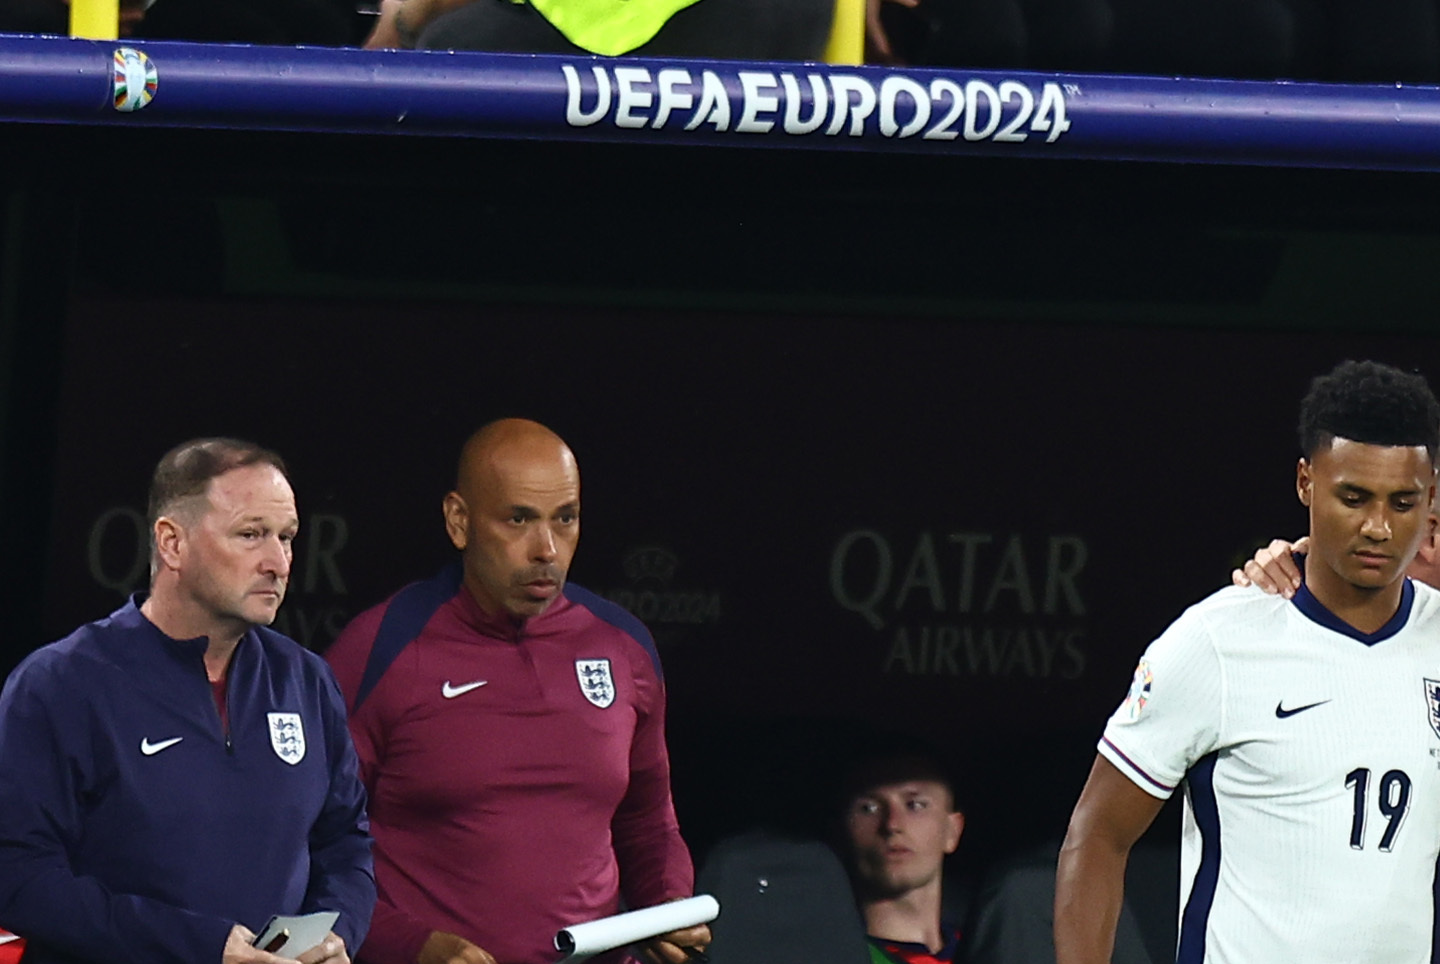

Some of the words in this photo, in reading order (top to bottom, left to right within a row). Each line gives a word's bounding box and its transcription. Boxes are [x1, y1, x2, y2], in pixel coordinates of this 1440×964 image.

[829, 527, 1089, 631] QATAR
[884, 624, 1087, 679] AIRWAYS
[1344, 767, 1413, 853] 19
